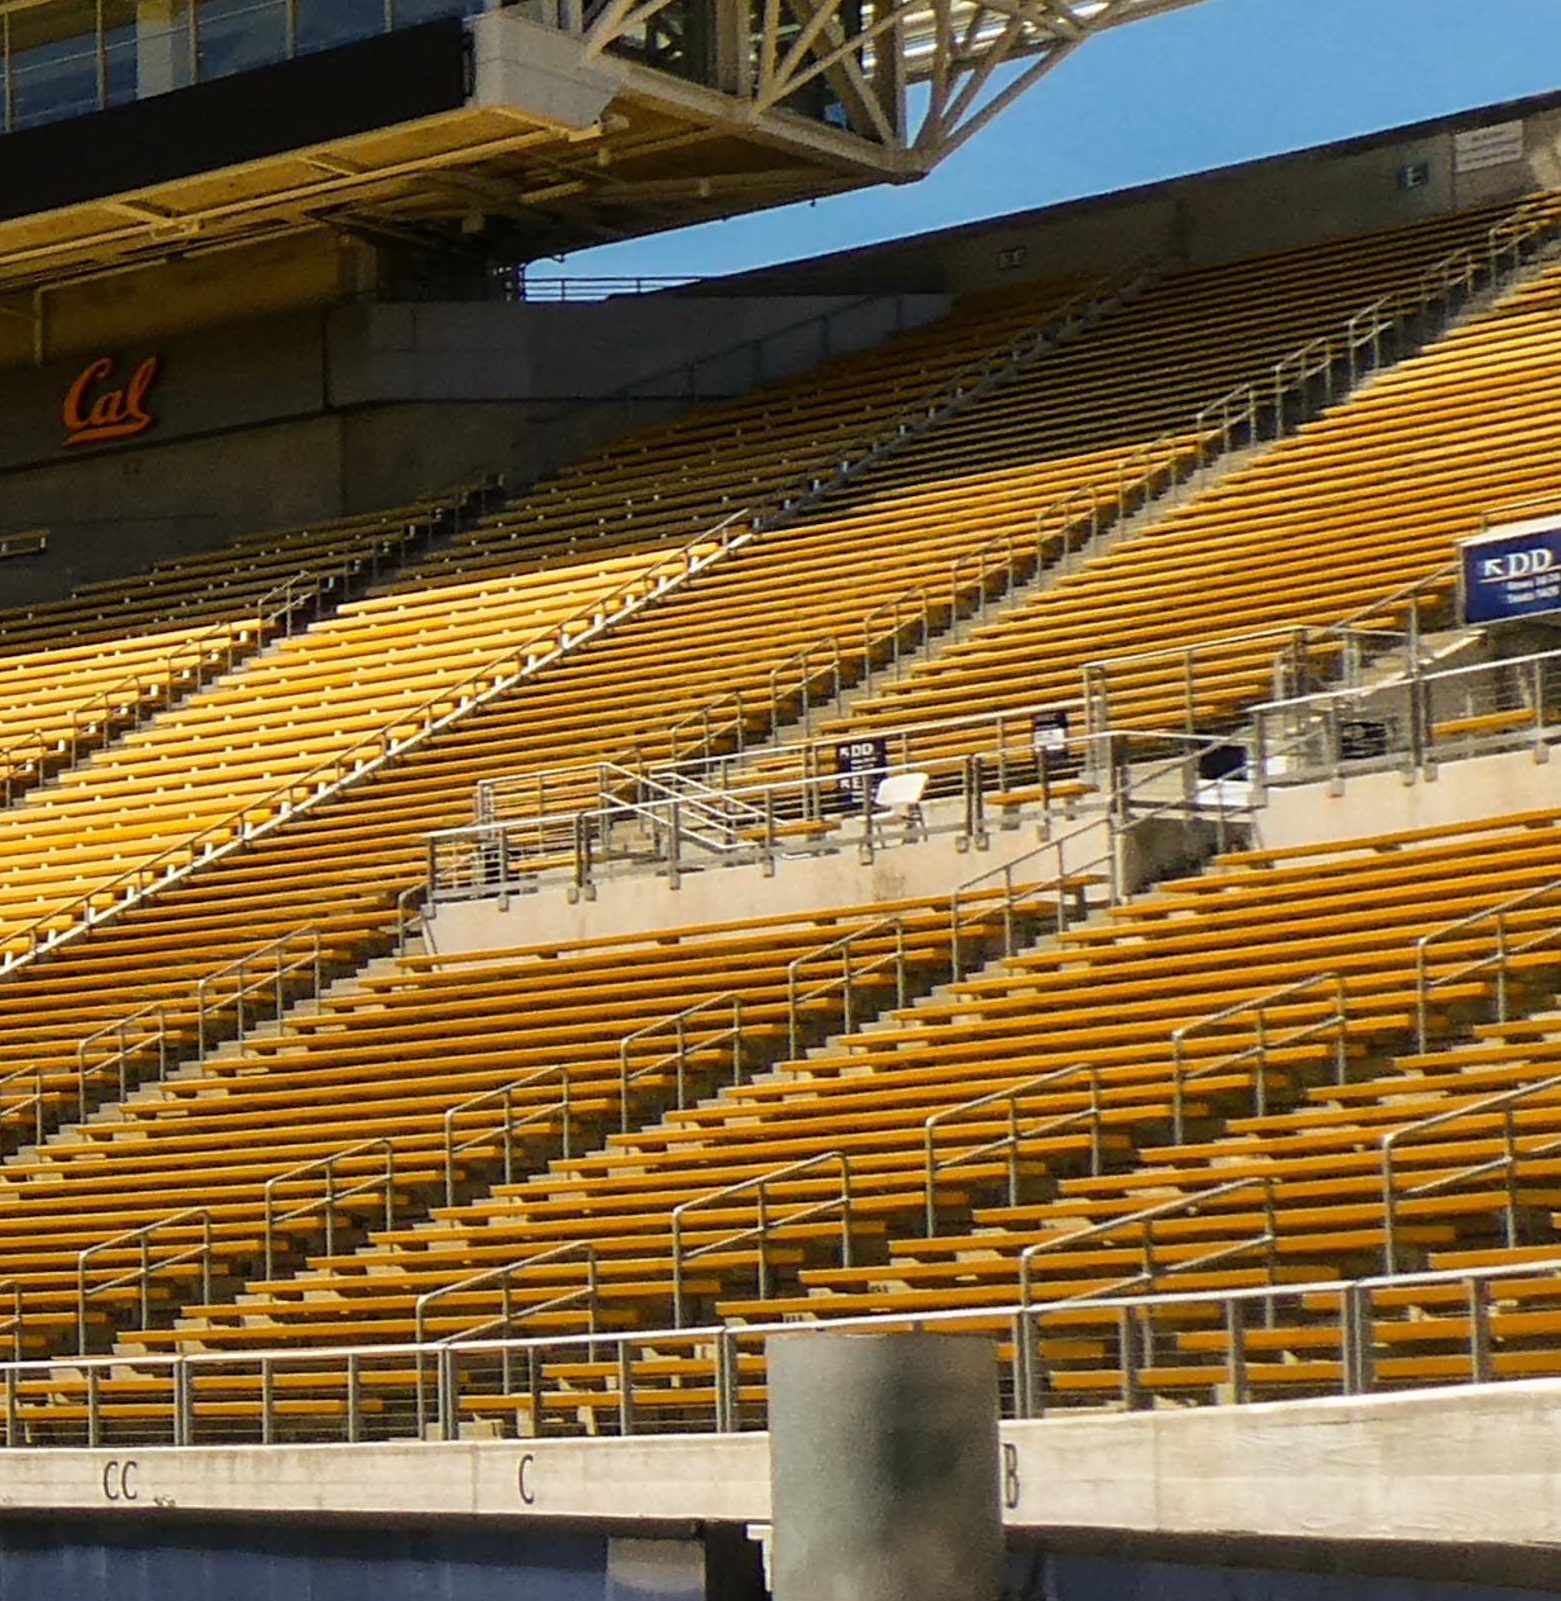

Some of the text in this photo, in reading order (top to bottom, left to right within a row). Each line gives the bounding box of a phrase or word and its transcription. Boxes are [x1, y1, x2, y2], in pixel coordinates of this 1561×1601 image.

[60, 356, 158, 448] Cal
[1507, 548, 1553, 576] DD
[103, 1461, 137, 1500] CC
[518, 1454, 535, 1505] C
